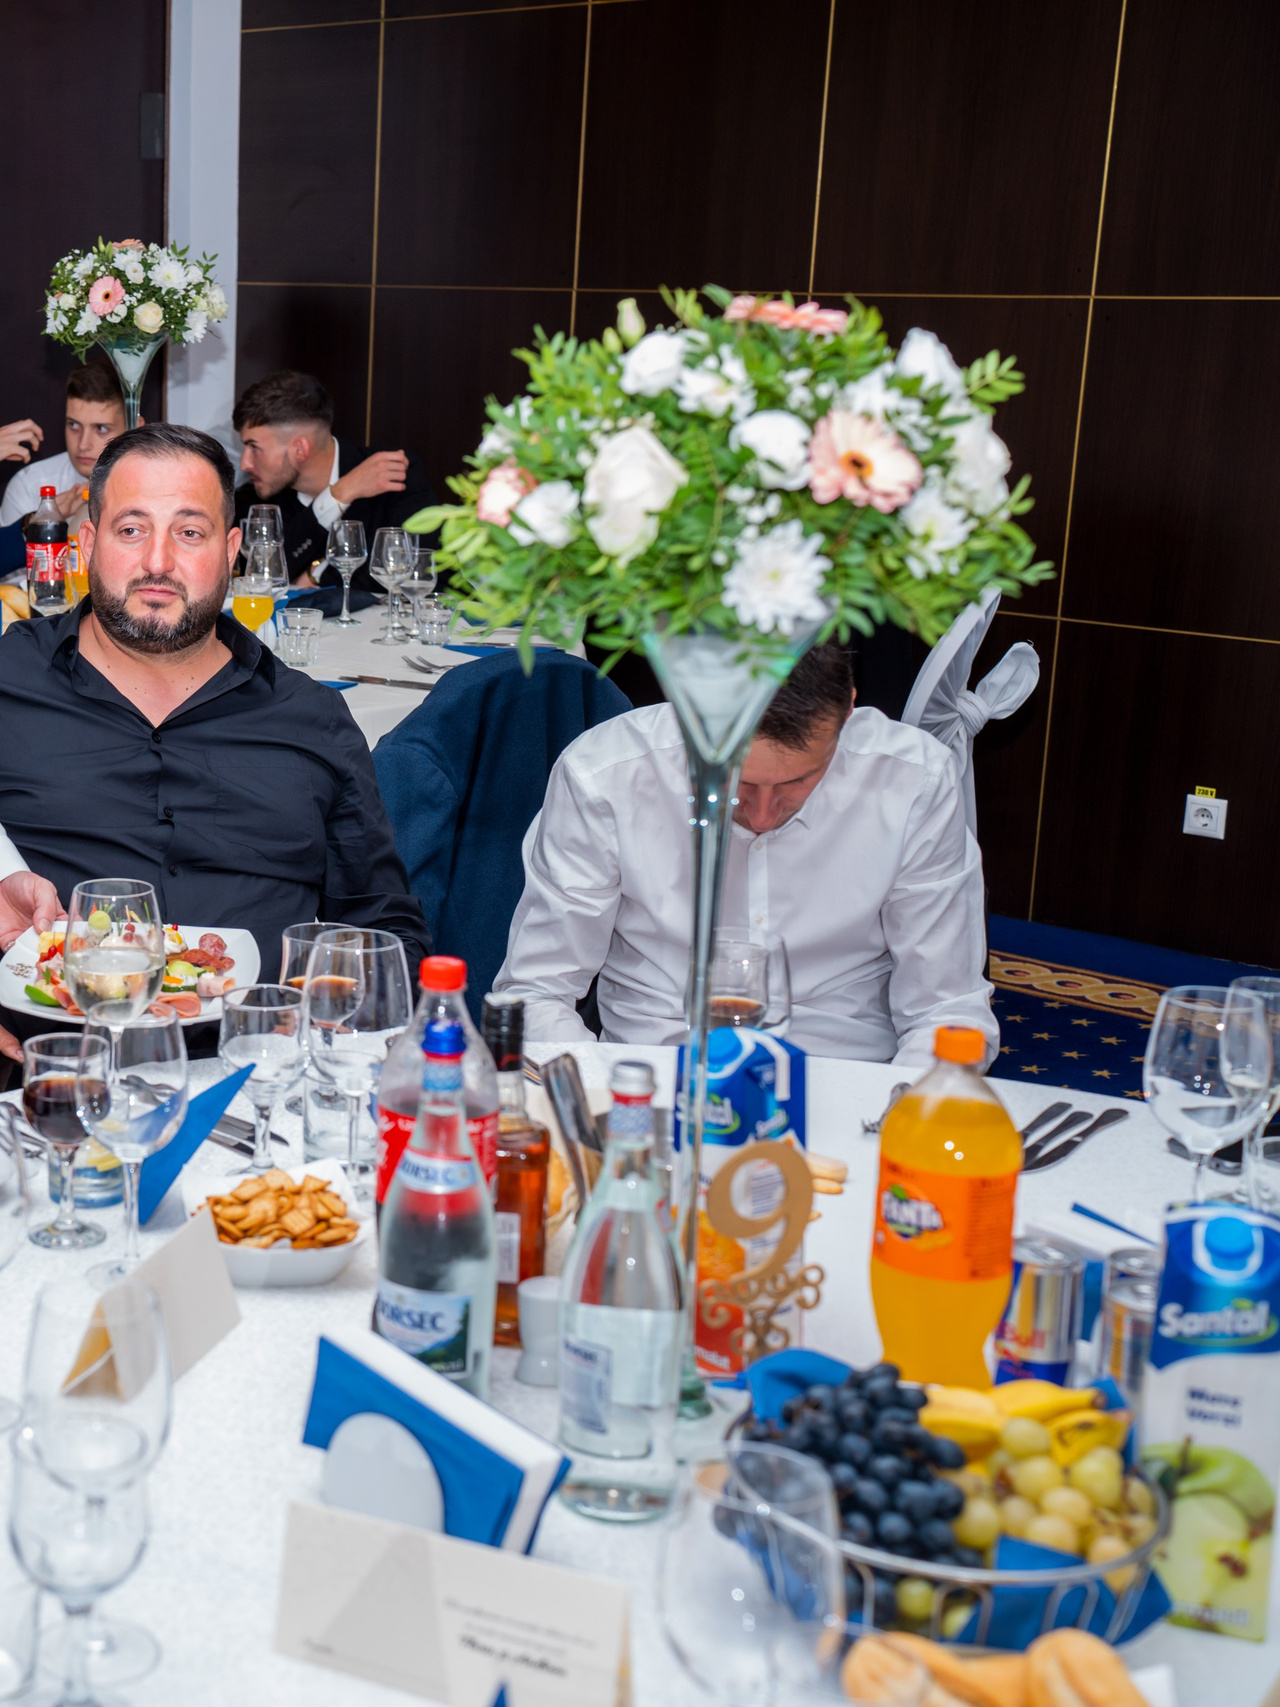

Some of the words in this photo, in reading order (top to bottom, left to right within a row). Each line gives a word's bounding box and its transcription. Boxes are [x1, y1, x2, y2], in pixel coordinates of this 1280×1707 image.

[676, 1092, 734, 1127] Stal
[706, 1141, 813, 1292] 9
[1158, 1299, 1270, 1339] Santal
